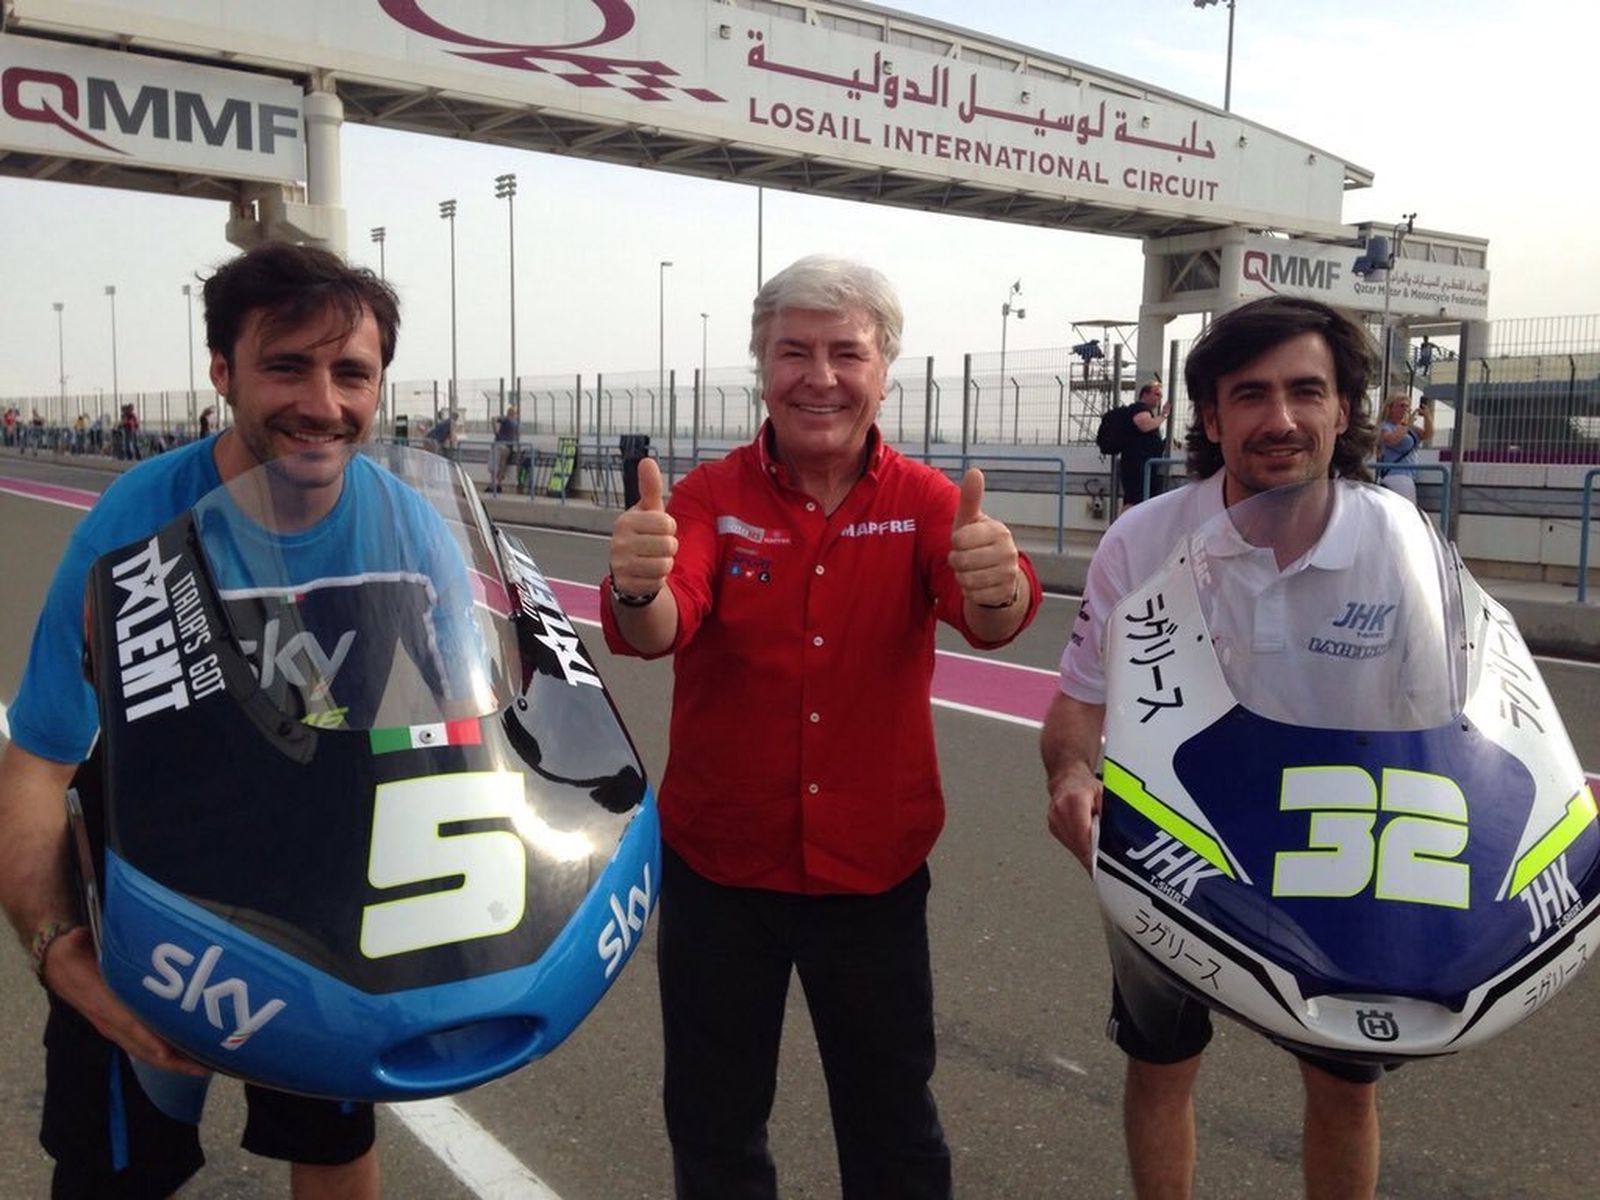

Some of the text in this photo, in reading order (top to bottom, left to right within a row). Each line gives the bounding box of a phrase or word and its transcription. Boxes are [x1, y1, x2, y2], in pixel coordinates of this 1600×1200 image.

[2, 67, 298, 155] QMMF
[747, 30, 1215, 162] حلبة لوسيل الدولية
[749, 97, 1219, 201] LOSAIL INTERNATIONAL CIRCUIT
[1243, 250, 1341, 294] QMMF
[1354, 282, 1377, 295] Qatar
[1378, 284, 1401, 297] Mtor
[1403, 287, 1409, 298] &
[1411, 288, 1450, 302] Motorcycle
[841, 519, 915, 537] MAPFRE
[112, 536, 189, 722] TALENT
[170, 571, 226, 700] ITALIA'S GOT
[1125, 593, 1184, 724] ラグリース
[1332, 602, 1396, 631] JHK
[359, 771, 527, 960] 5
[1125, 830, 1225, 898] JHK
[1272, 765, 1470, 909] 32
[597, 862, 653, 980] sky
[1150, 874, 1189, 905] T-SHIRT
[1519, 852, 1581, 943] JHK
[142, 941, 287, 1051] sky
[1135, 908, 1222, 990] ラグリース
